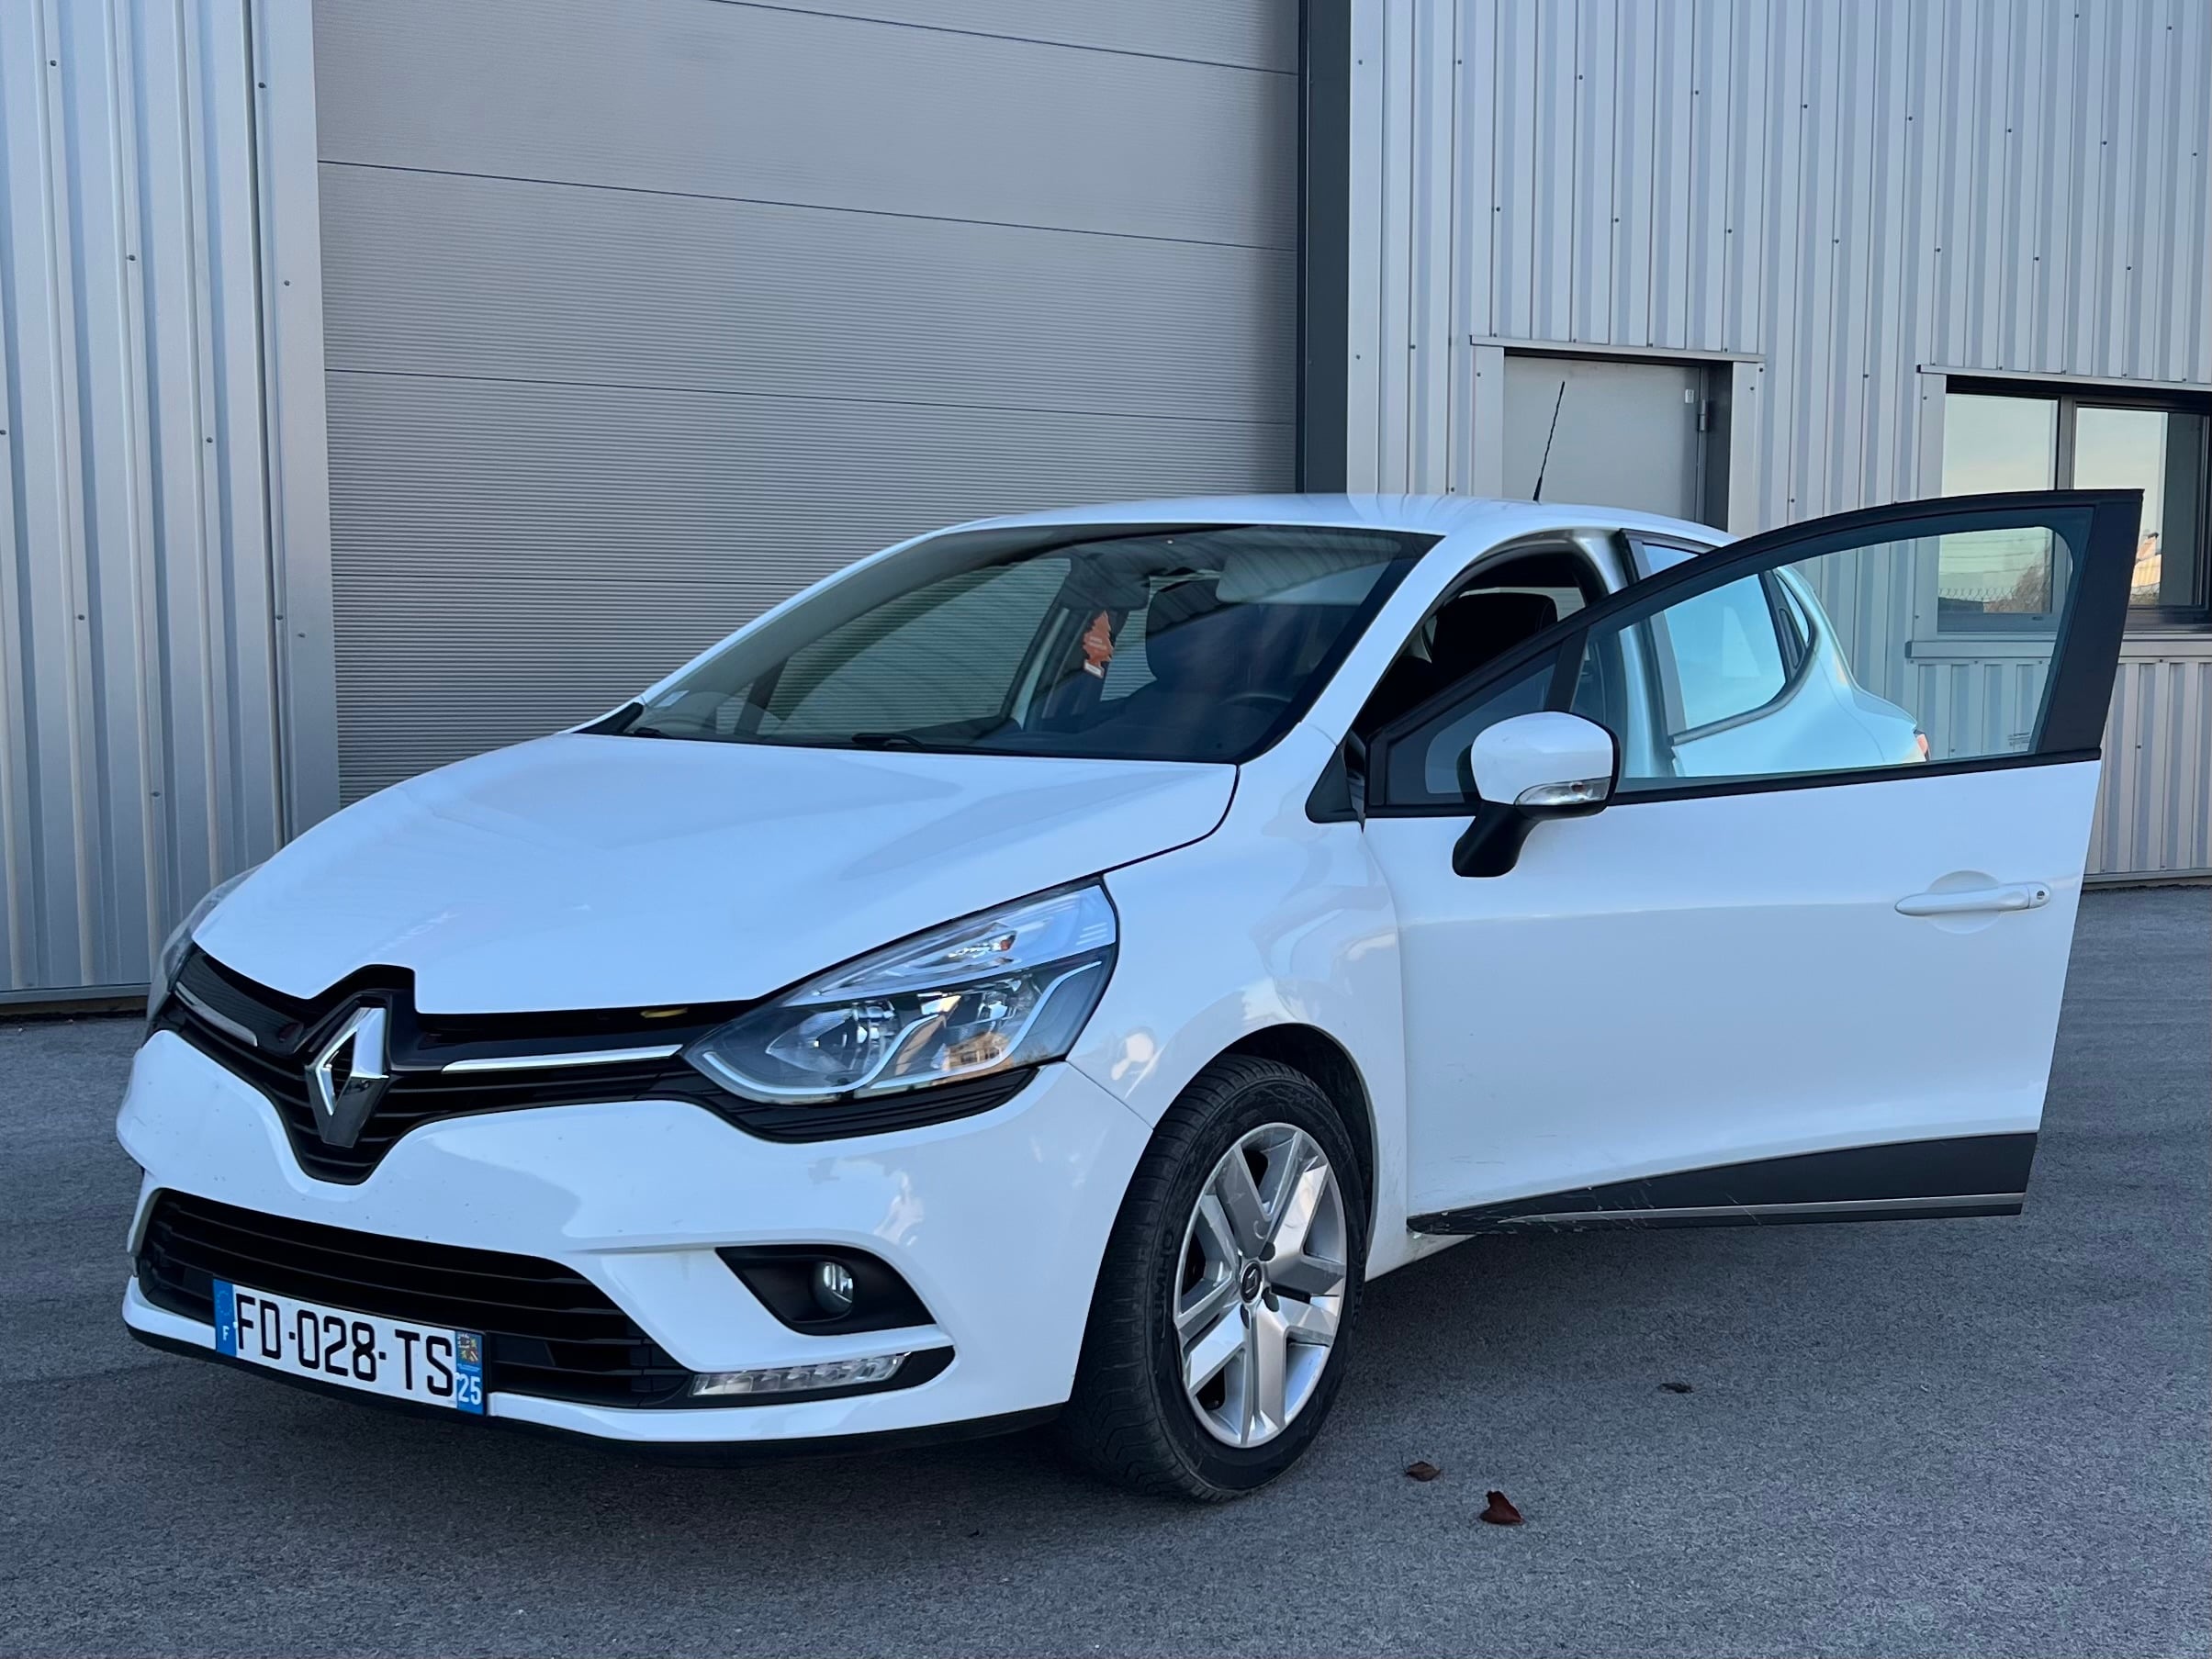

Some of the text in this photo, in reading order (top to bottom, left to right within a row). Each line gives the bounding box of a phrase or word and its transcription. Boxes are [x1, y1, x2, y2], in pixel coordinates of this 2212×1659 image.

[222, 1325, 230, 1341] F
[235, 1293, 454, 1397] FD-028-TS
[458, 1373, 482, 1406] 25
